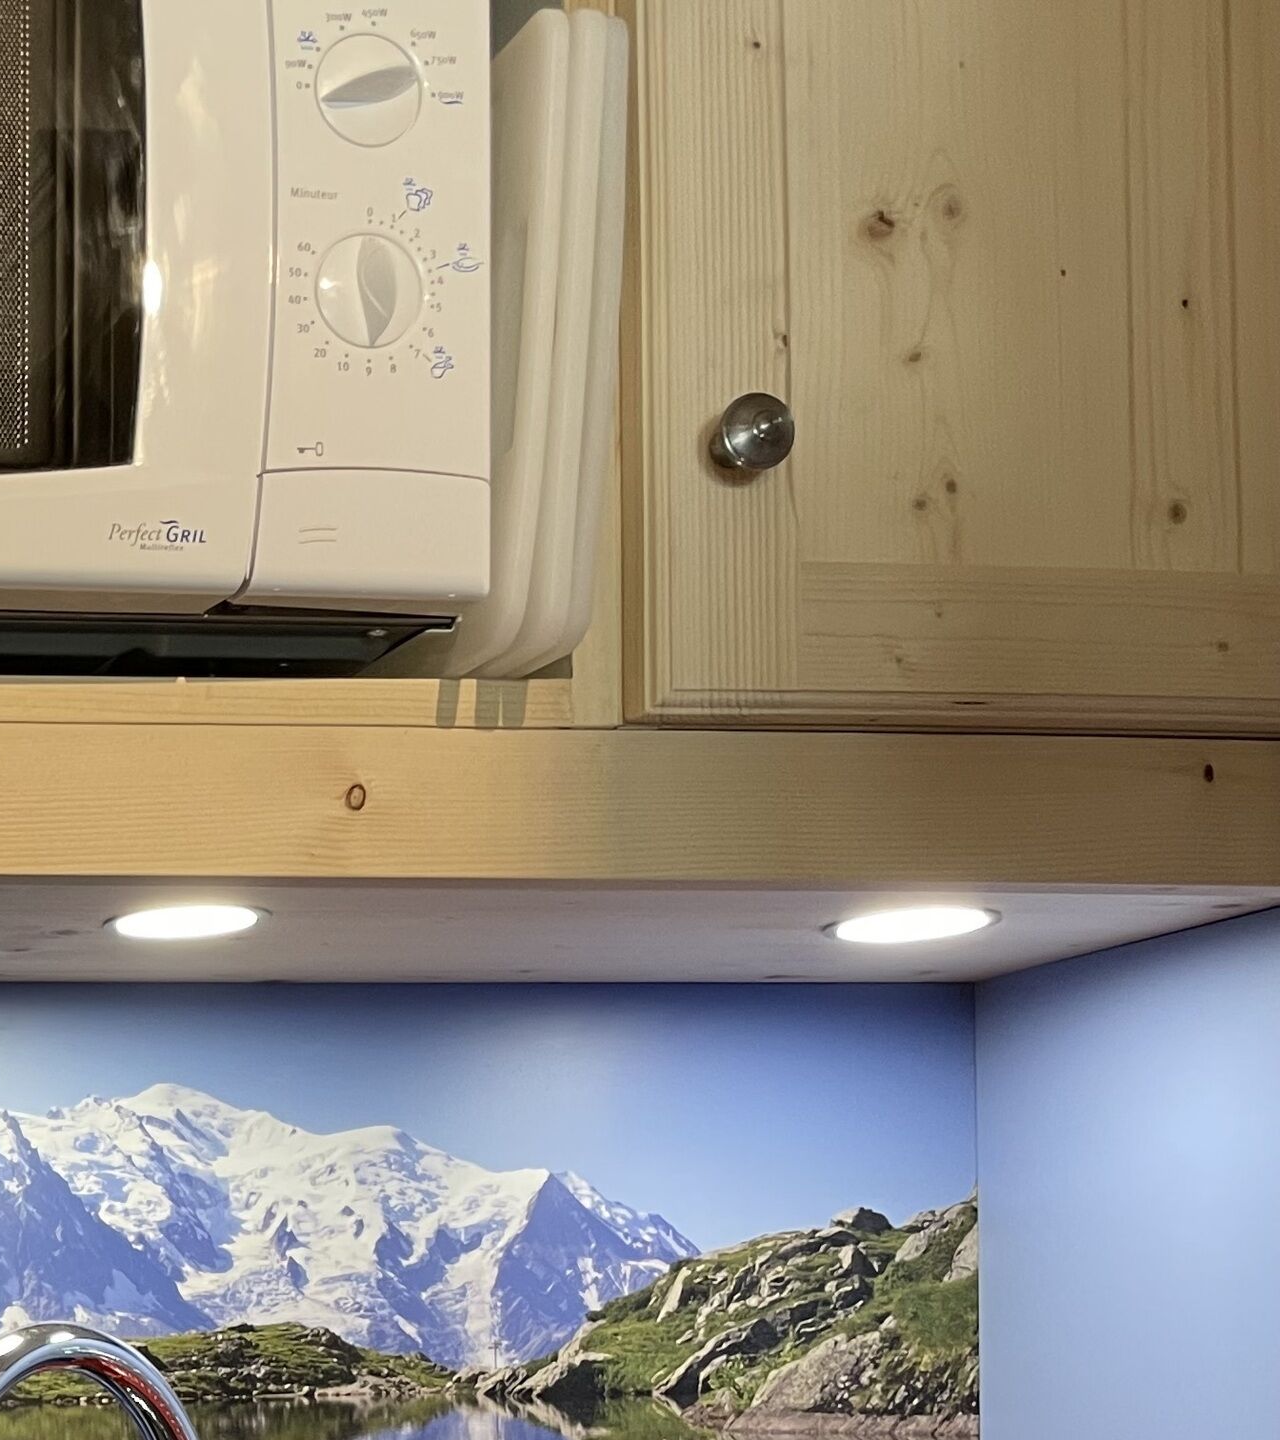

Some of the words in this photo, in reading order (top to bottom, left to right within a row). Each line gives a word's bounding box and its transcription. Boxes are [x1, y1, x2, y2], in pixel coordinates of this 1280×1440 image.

[295, 81, 302, 90] 0
[290, 186, 338, 201] Minuteur
[366, 206, 374, 217] 0
[413, 228, 421, 239] 2
[297, 242, 311, 252] 60
[429, 250, 437, 260] 3
[288, 267, 302, 278] 50
[436, 275, 444, 286] 4
[288, 295, 301, 305] 40
[435, 303, 442, 313] 5
[297, 323, 310, 334] 30
[427, 327, 435, 338] 6
[313, 348, 327, 359] 20
[413, 349, 421, 359] 7
[337, 361, 350, 372] 10
[365, 365, 373, 376] 9
[389, 363, 397, 374] 8
[108, 522, 162, 547] Perfect
[165, 525, 207, 544] GRIL
